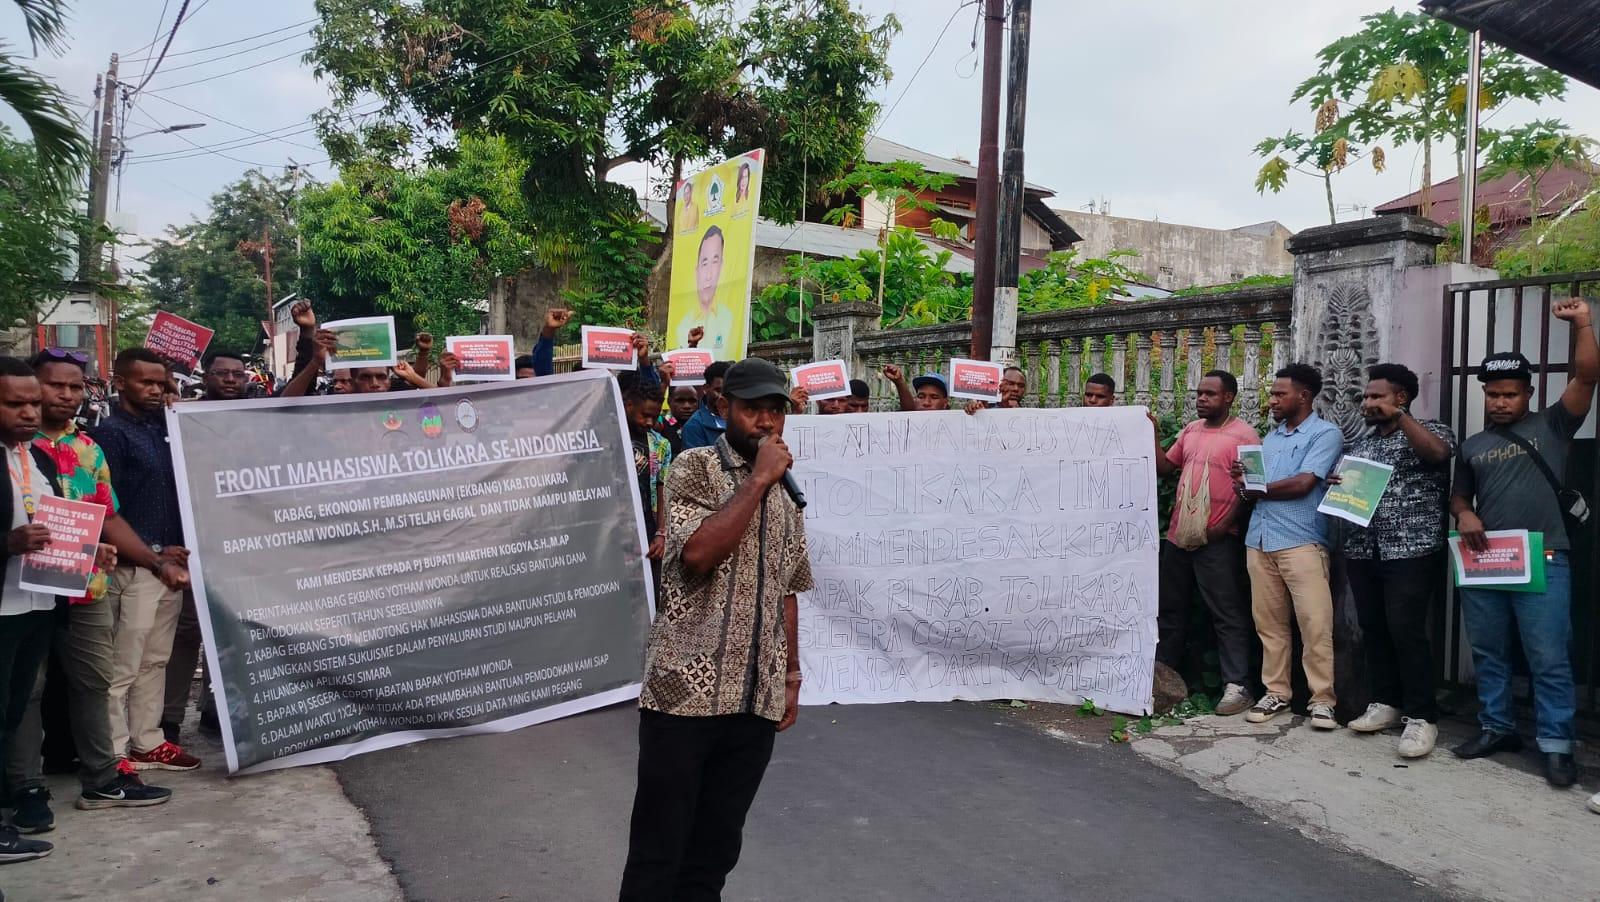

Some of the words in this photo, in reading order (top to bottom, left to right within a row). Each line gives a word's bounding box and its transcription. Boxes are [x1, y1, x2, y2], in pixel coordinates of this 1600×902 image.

[214, 465, 281, 493] FRONT
[287, 453, 402, 484] MAHASISWA
[403, 442, 489, 471] TOLIKARA
[491, 429, 600, 459] SE-INDONESIA
[792, 418, 910, 461] IKATAN
[910, 415, 1125, 457] MAHASISWA
[274, 505, 316, 523] KABAG,
[318, 497, 371, 517] EKONOMI
[373, 486, 457, 511] PEMBANGUNAN
[456, 482, 502, 500] (EKBANG)
[503, 472, 568, 490] KAB.TOLIKARA
[804, 463, 1041, 520] TOLIKARA
[48, 514, 76, 526] RATUS
[71, 511, 95, 521] TIGA
[223, 537, 263, 553] BAPAK
[265, 531, 314, 548] YOTHAM
[409, 510, 441, 526] TELAH
[443, 505, 476, 521] GAGAL
[480, 502, 501, 516] DAN
[503, 497, 532, 512] TIDAK
[533, 493, 567, 509] MAMPU
[569, 486, 611, 504] MELAYANI
[53, 548, 88, 561] BAYAR
[1060, 520, 1159, 559] KEPADA
[296, 577, 321, 590] KAMI
[324, 567, 376, 586] MENDESAK
[377, 562, 411, 577] KEPADA
[413, 559, 423, 572] PJ
[424, 555, 455, 569] BUPATI
[456, 548, 498, 564] MARTHEN
[315, 595, 347, 611] KABAG
[349, 587, 385, 604] EKBANG
[386, 581, 424, 597] YOTHAM
[425, 576, 459, 590] WONDA
[461, 571, 490, 585] UNTUK
[491, 562, 528, 578] REALISASI
[529, 555, 565, 573] BANTUAN
[566, 551, 587, 565] DANA
[925, 576, 990, 617] KAB.
[1000, 572, 1143, 614] TOLIKARA
[250, 620, 314, 641] PEMODOKAN
[315, 615, 351, 631] SEPERTI
[351, 607, 384, 624] TAHUN
[385, 597, 444, 618] SEBELUMNYA
[288, 638, 327, 656] EKBANG
[328, 633, 352, 649] STOP
[353, 622, 410, 645] MEMOTONG
[411, 618, 429, 633] HAK
[430, 608, 481, 628] MAHASISWA
[482, 604, 505, 620] DANA
[505, 596, 543, 615] BANTUAN
[543, 592, 567, 607] STUDI
[567, 589, 573, 601] &
[574, 581, 620, 599] PEMODOKAN
[313, 657, 347, 672] SISTEM
[349, 646, 394, 666] SUKUISME
[396, 641, 426, 656] DALAM
[428, 626, 482, 648] PENYALURAN
[483, 622, 507, 637] STUDI
[508, 616, 543, 632] MAUPUN
[544, 607, 577, 625] PELAYAN
[911, 618, 1012, 651] COPOT
[297, 704, 307, 715] PJ
[306, 691, 341, 710] SEGERA
[342, 688, 374, 699] COPOT
[375, 681, 414, 699] JABATAN
[415, 674, 444, 690] BAPAK
[444, 665, 480, 683] YOTHAM
[481, 658, 513, 675] WONDA
[304, 713, 336, 731] WAKTU
[337, 705, 357, 722] 1X24
[358, 703, 375, 716] JAM
[376, 700, 404, 713] TIDAK
[405, 697, 424, 710] ADA
[425, 683, 484, 707] PENAMBAHAN
[485, 674, 524, 692] BANTUAN
[524, 665, 574, 685] PEMODOKAN
[574, 659, 593, 671] KAMI
[593, 653, 610, 667] SIAP
[315, 674, 355, 687] APLIKASI
[357, 665, 392, 684] SIMARA
[927, 651, 992, 688] DARI
[352, 718, 387, 733] YOTHAM
[388, 715, 424, 726] WONDA
[426, 713, 437, 723] DI
[438, 709, 455, 721] KPK
[456, 705, 485, 720] SESUAI
[486, 698, 508, 713] DATA
[508, 692, 531, 707] YANG
[531, 688, 550, 702] KAMI
[551, 679, 583, 696] PEGANG
